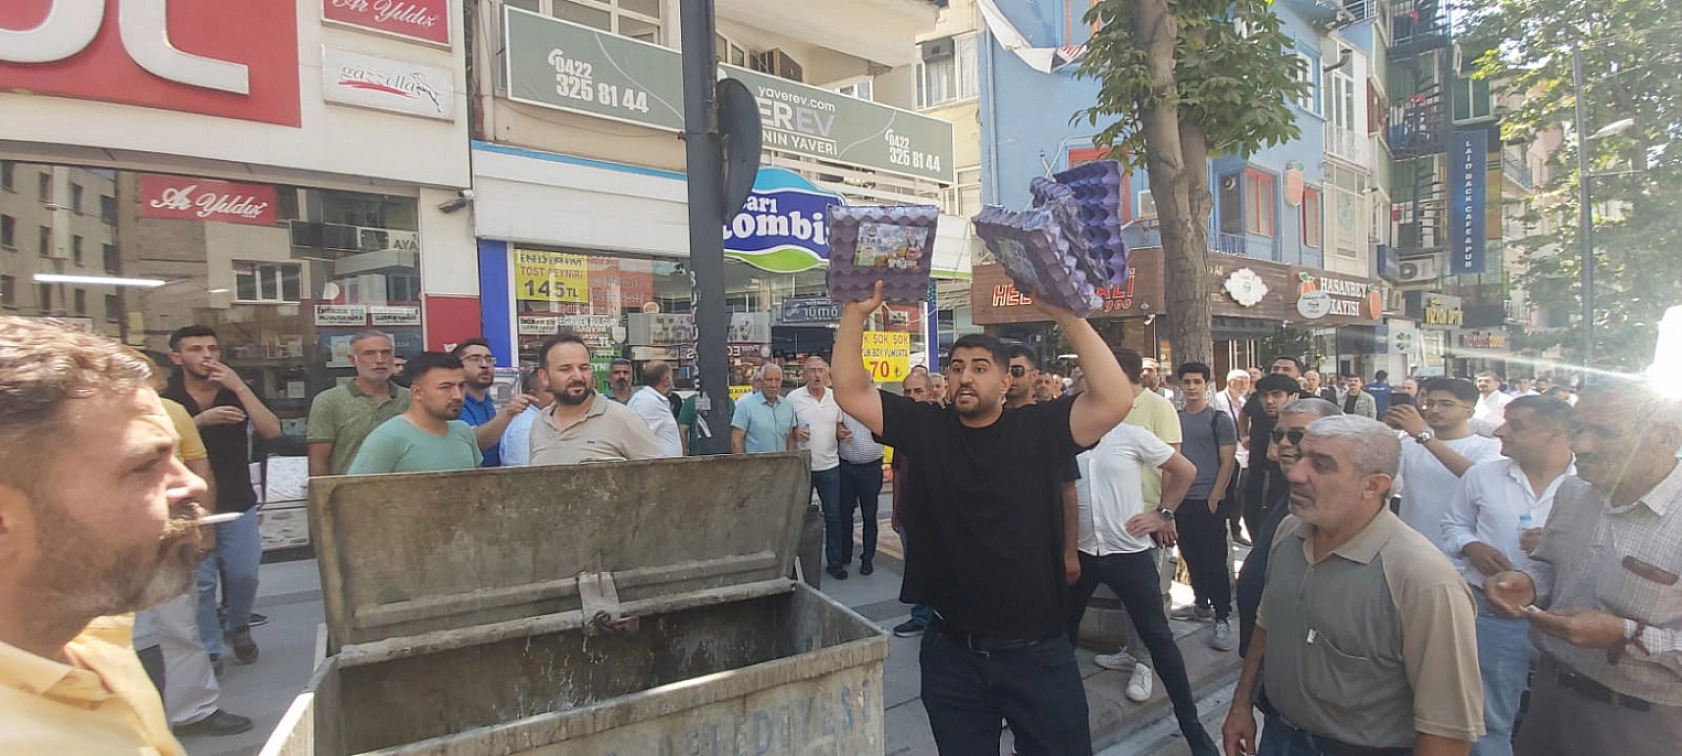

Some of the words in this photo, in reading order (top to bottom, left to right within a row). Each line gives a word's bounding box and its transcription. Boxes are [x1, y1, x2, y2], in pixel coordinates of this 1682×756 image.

[555, 57, 592, 79] 0422
[556, 74, 593, 101] 325
[598, 83, 618, 107] 81
[622, 89, 649, 113] 44
[758, 86, 835, 113] yaverev.com
[791, 136, 838, 156] YAVERİ
[889, 135, 909, 149] 0422
[889, 147, 910, 166] 325
[913, 152, 924, 169] 81
[926, 156, 941, 172] 44
[196, 192, 269, 217] Yıldız
[743, 195, 778, 214] arı
[723, 211, 829, 245] ombi
[1320, 276, 1368, 299] HASANBEY
[1101, 299, 1133, 313] 900
[869, 360, 890, 378] 70
